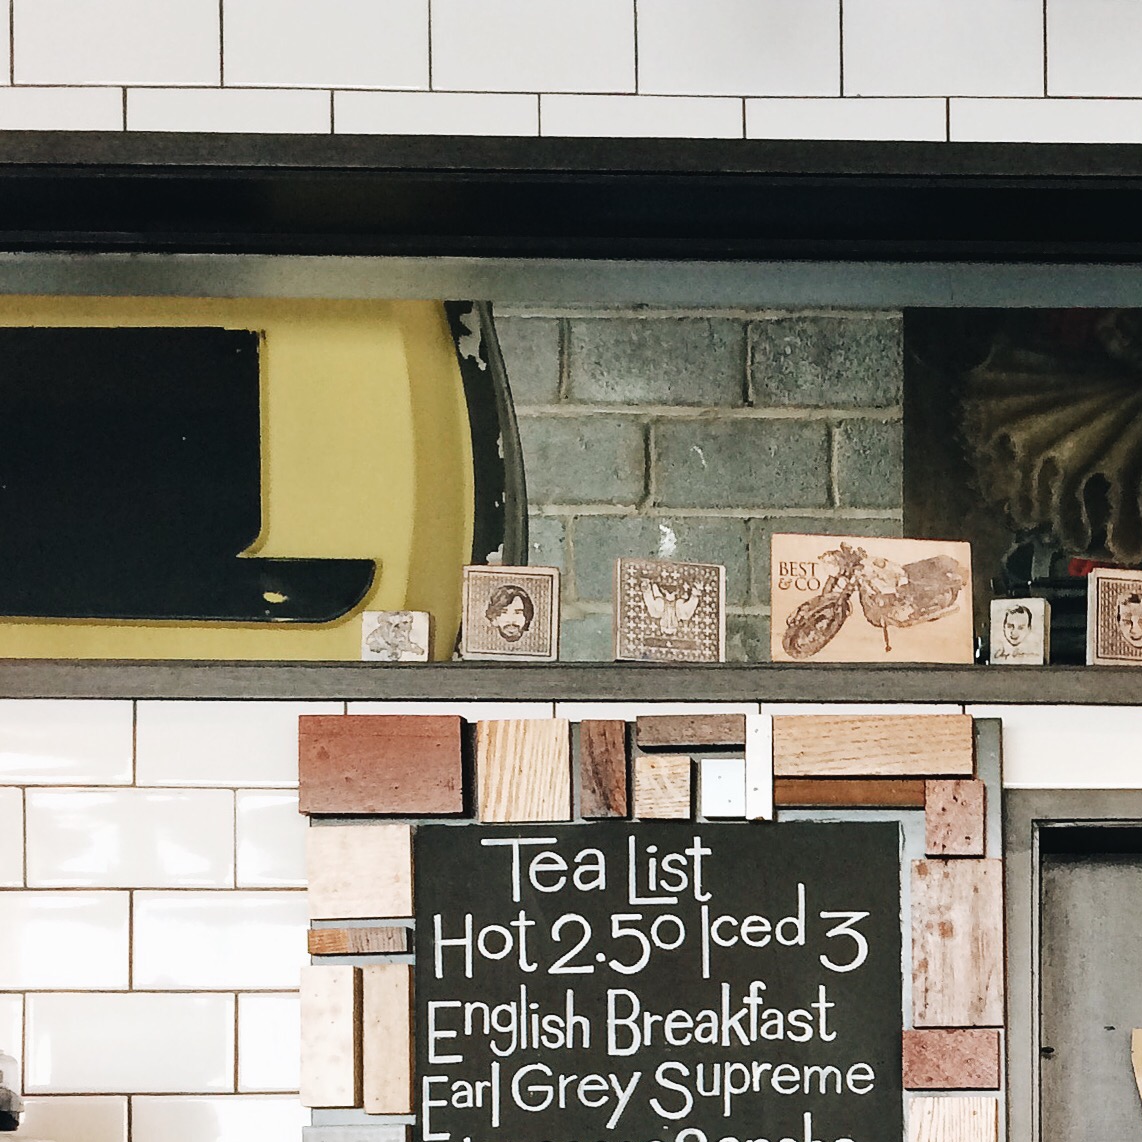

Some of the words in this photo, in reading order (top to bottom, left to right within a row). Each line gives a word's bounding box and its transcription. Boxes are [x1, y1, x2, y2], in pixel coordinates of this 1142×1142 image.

[778, 577, 792, 590] &
[795, 577, 820, 591] CO
[779, 562, 818, 577] BEST
[481, 837, 606, 902] Tea
[628, 835, 713, 905] List
[433, 910, 538, 979] Hot
[547, 913, 686, 975] 2.50
[701, 882, 806, 979] Iced
[819, 910, 870, 973] 3
[427, 984, 591, 1064] English
[606, 980, 837, 1057] Breakfast
[421, 1060, 500, 1142] Earl
[511, 1062, 642, 1130] Grey
[649, 1061, 875, 1120] Supreme
